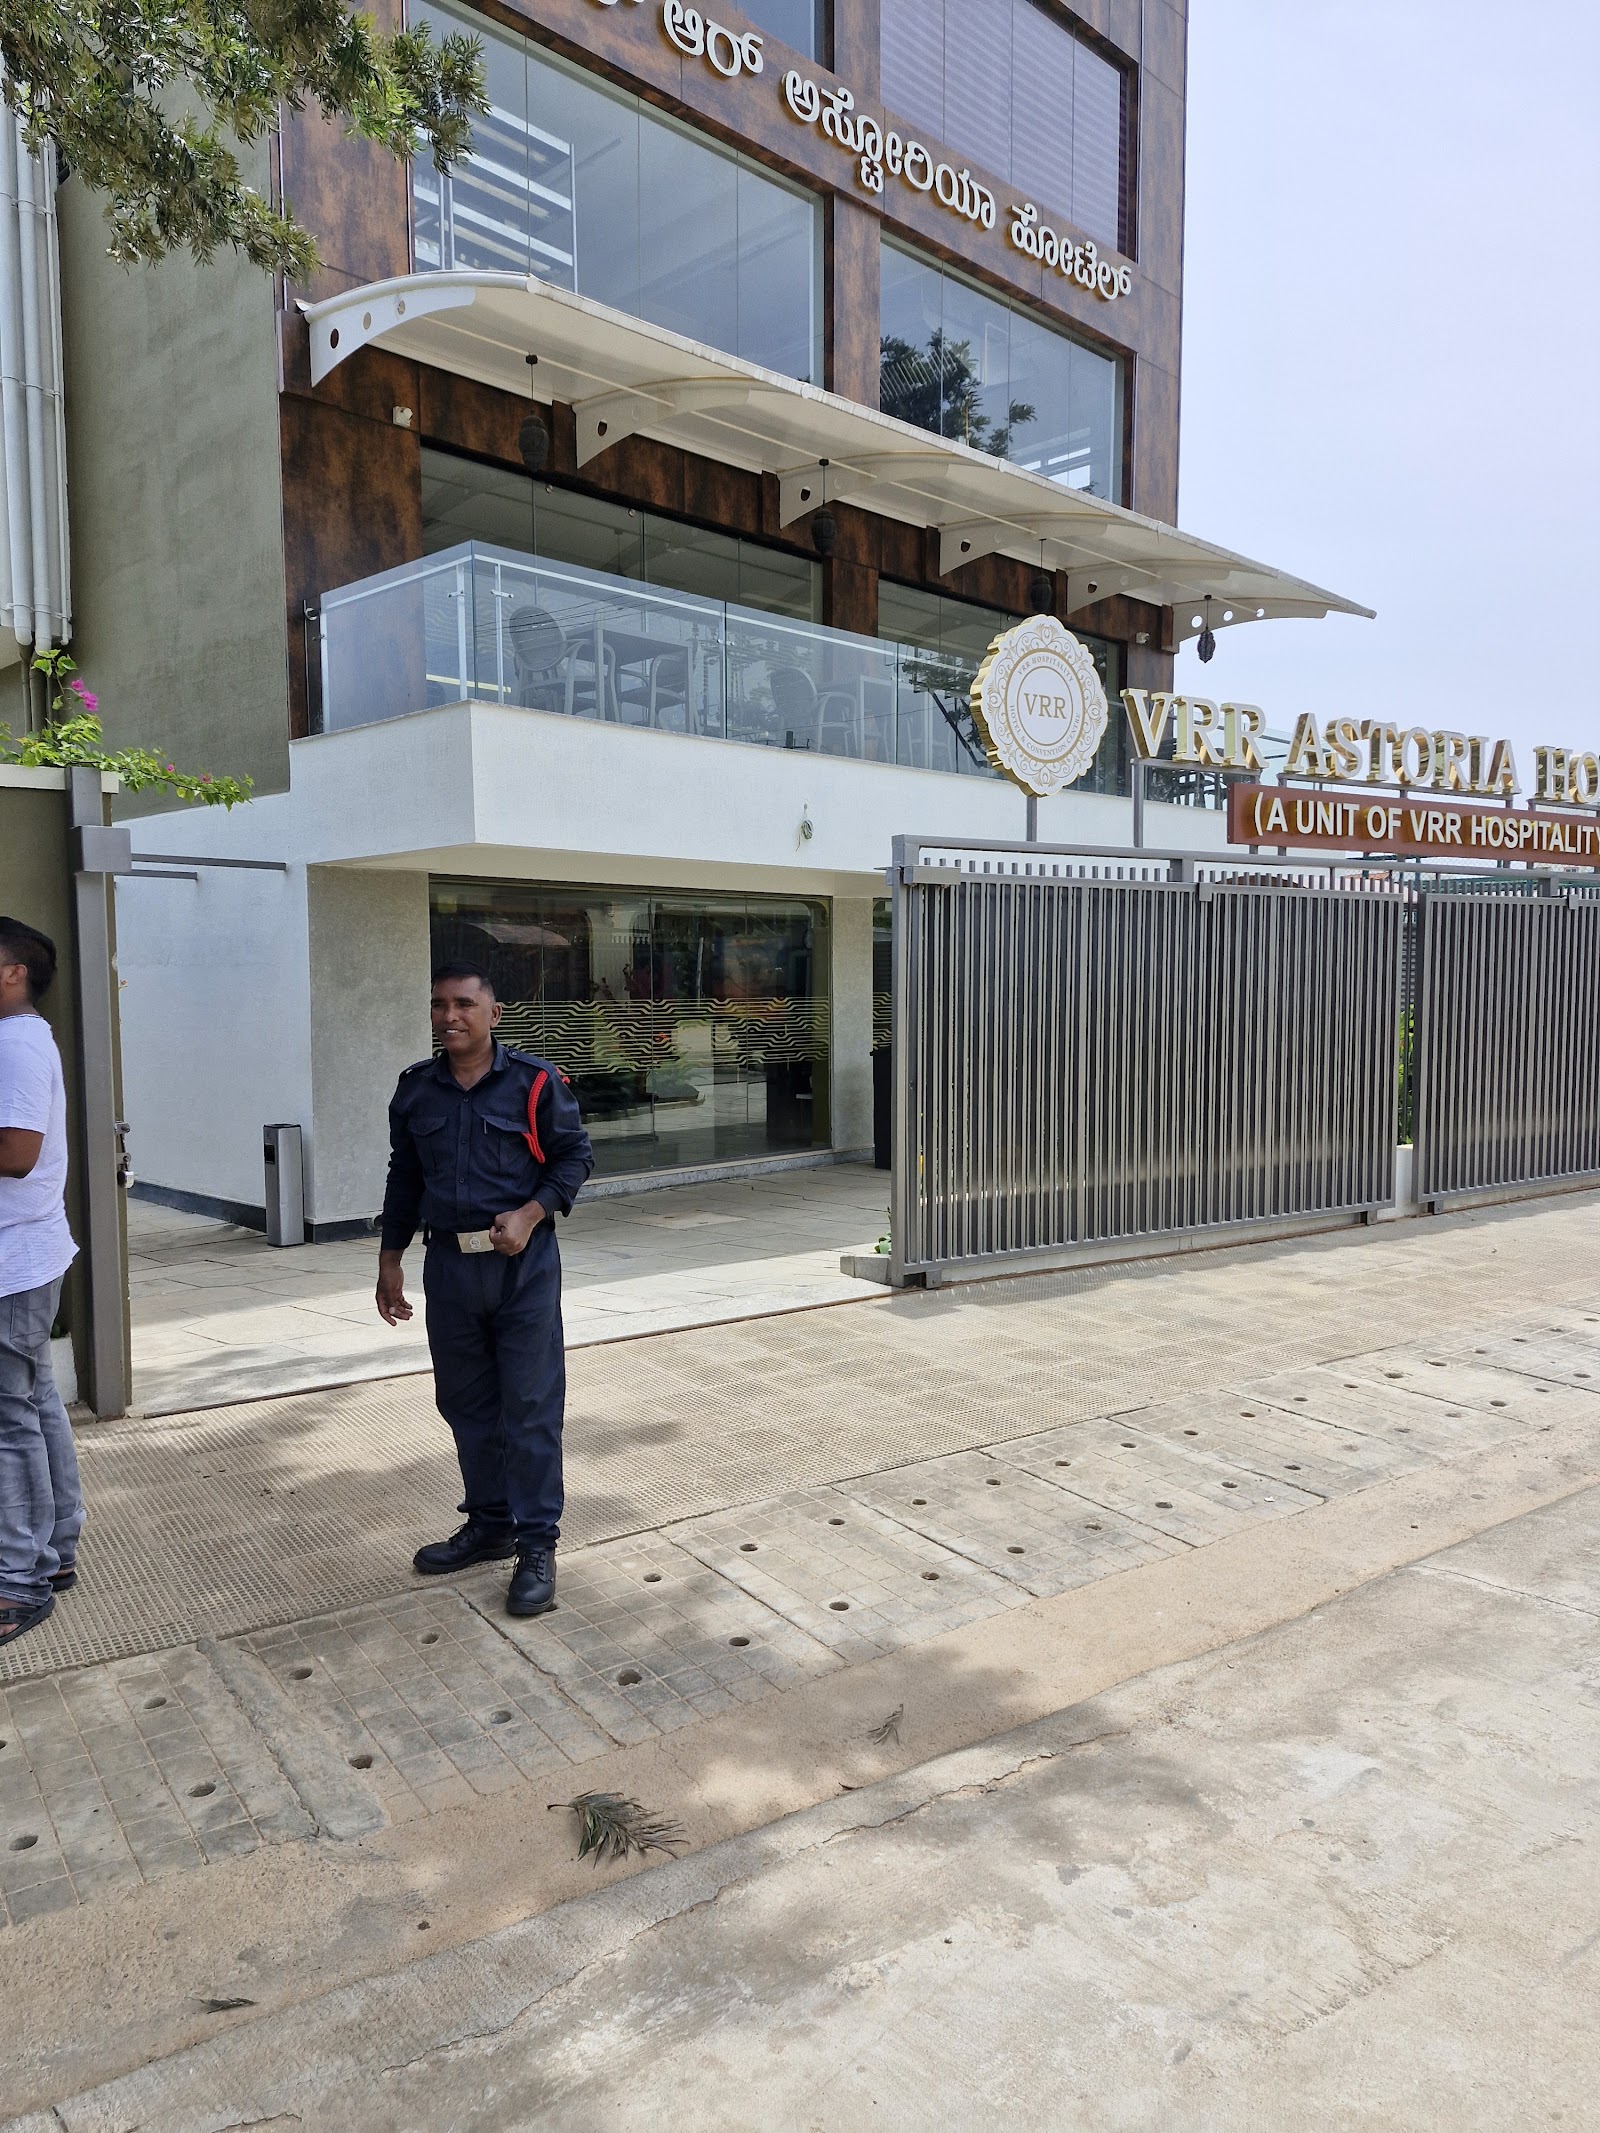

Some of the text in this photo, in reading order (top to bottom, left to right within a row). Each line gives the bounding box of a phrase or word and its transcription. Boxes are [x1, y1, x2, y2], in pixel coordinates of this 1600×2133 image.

[664, 0, 763, 77] ಆರ್
[1010, 202, 1132, 300] ಹೋಟೆಲ್
[1018, 655, 1074, 682] VRR HOSPITALITY
[1009, 704, 1021, 735] HOTEL
[1026, 741, 1067, 756] CONVENTION
[1066, 712, 1081, 744] CENTRE
[1024, 692, 1067, 720] VRR
[1120, 688, 1600, 803] VRR ASTORIA HO
[1254, 791, 1288, 836] (A
[1296, 799, 1360, 837] UNIT
[1366, 805, 1403, 840] OF
[1410, 809, 1463, 845] VRR
